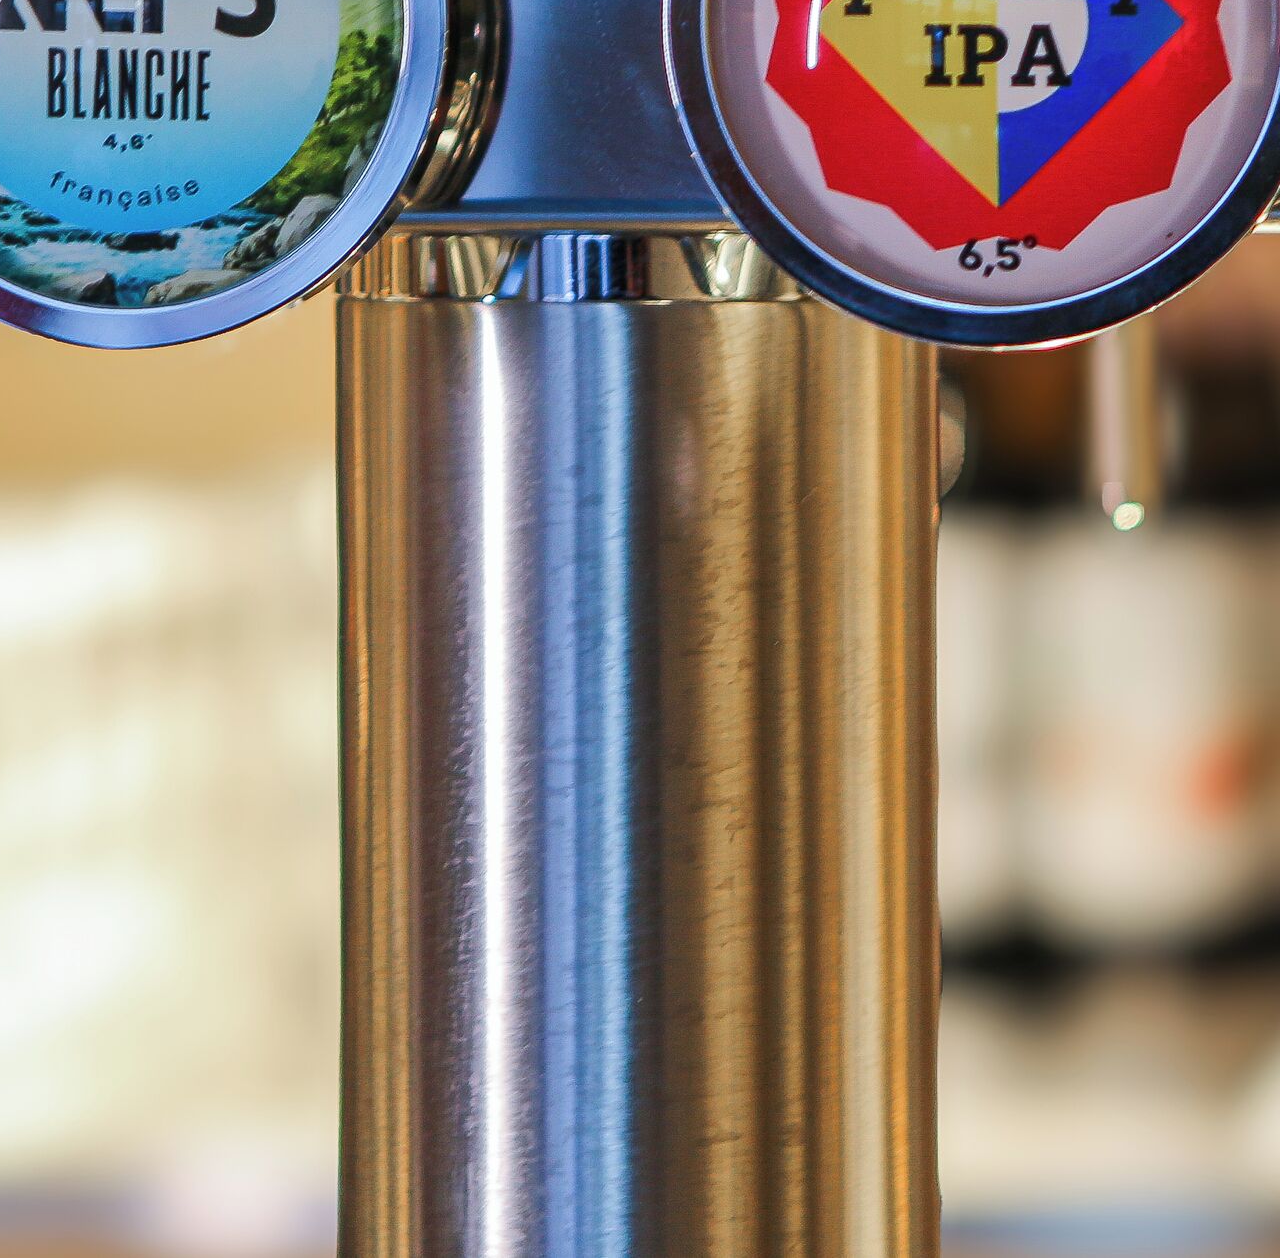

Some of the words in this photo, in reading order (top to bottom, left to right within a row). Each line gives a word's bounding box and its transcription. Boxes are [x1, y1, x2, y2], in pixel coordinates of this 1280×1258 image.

[925, 24, 1071, 88] IPA
[47, 47, 212, 122] BLANCHE
[50, 170, 200, 210] française
[959, 234, 1038, 277] 6,5°
